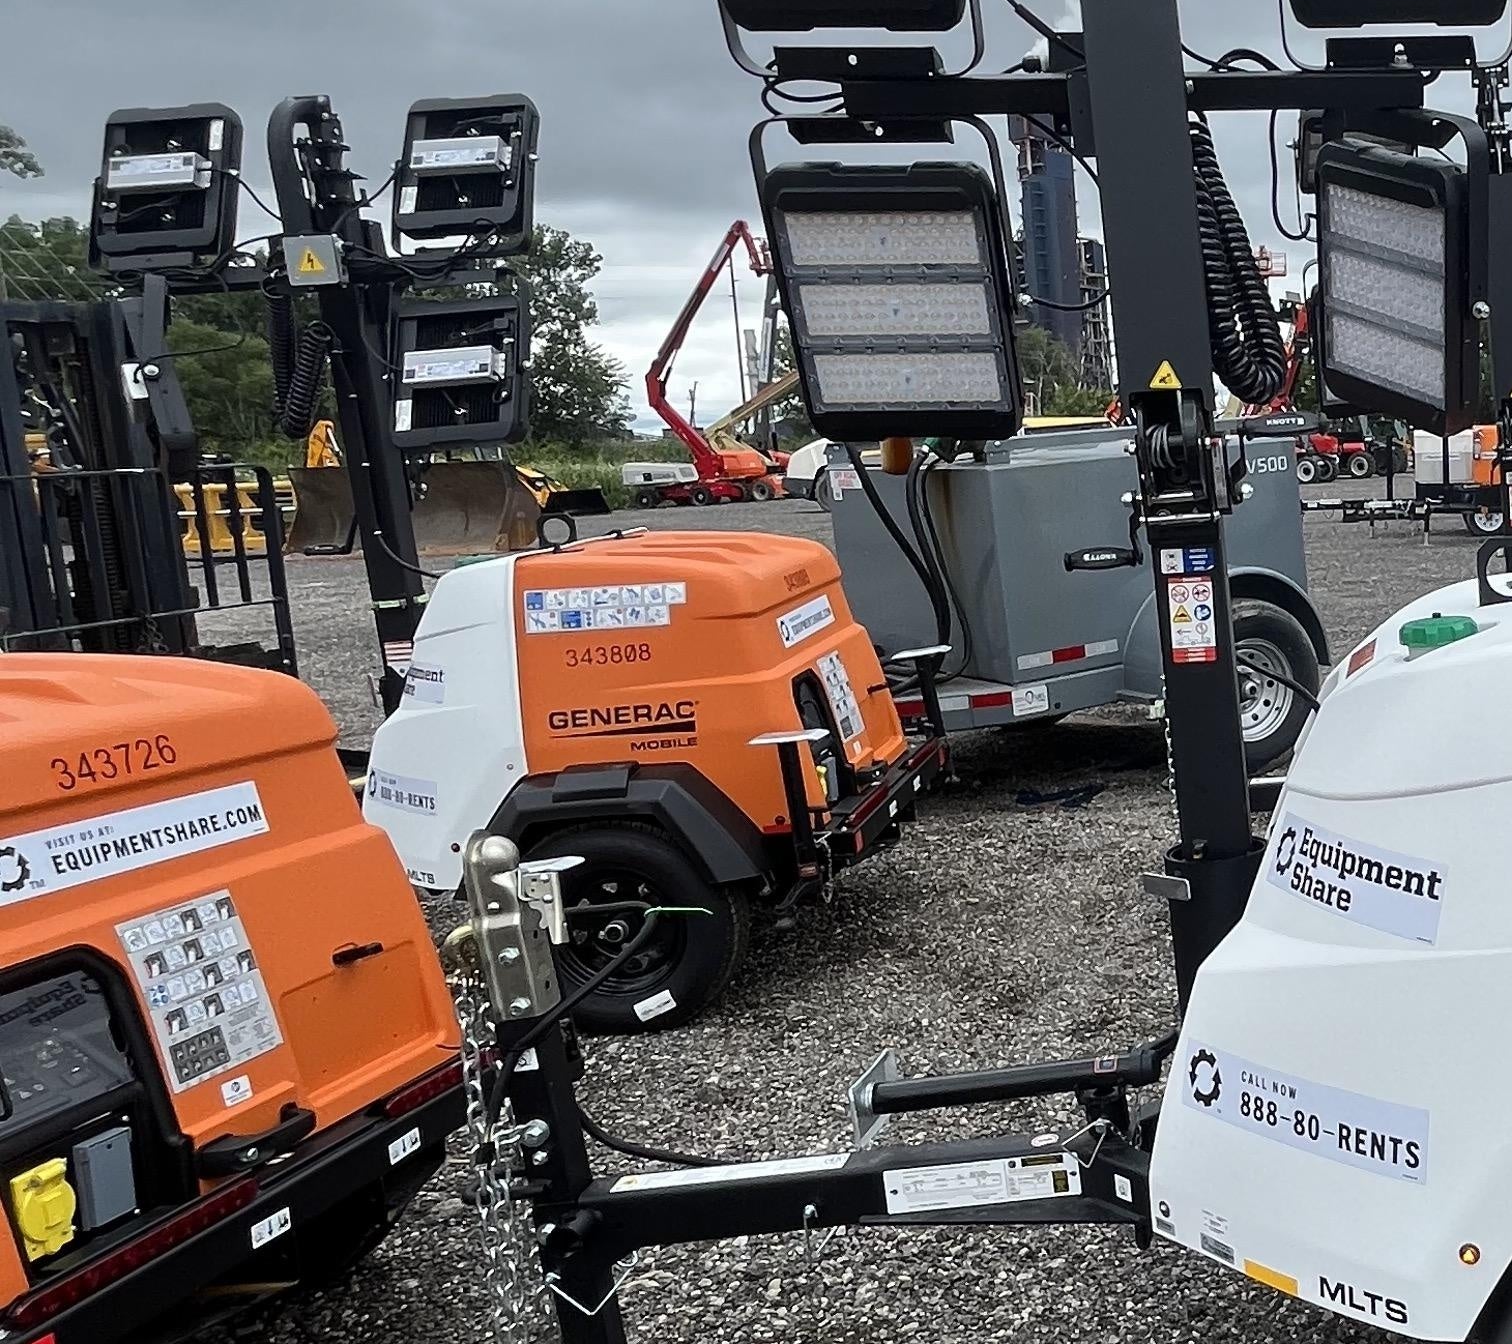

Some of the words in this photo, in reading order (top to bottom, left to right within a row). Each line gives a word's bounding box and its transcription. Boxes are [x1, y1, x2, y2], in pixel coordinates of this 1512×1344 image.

[1266, 417, 1297, 426] KNOTT
[565, 643, 652, 667] 343808
[548, 701, 696, 730] GENERAC
[51, 735, 176, 790] 343726
[630, 736, 698, 752] MOBILE
[44, 835, 76, 851] VISIT
[79, 830, 95, 844] US
[51, 804, 262, 875] EQUIPMENTSHARE.COM
[1299, 827, 1442, 901] Equipment
[1290, 862, 1352, 912] Share
[1241, 1070, 1267, 1090] CALL
[1272, 1081, 1297, 1100] NOW
[1240, 1091, 1420, 1169] 888-80-RENTS
[1319, 1276, 1408, 1324] MLTS
